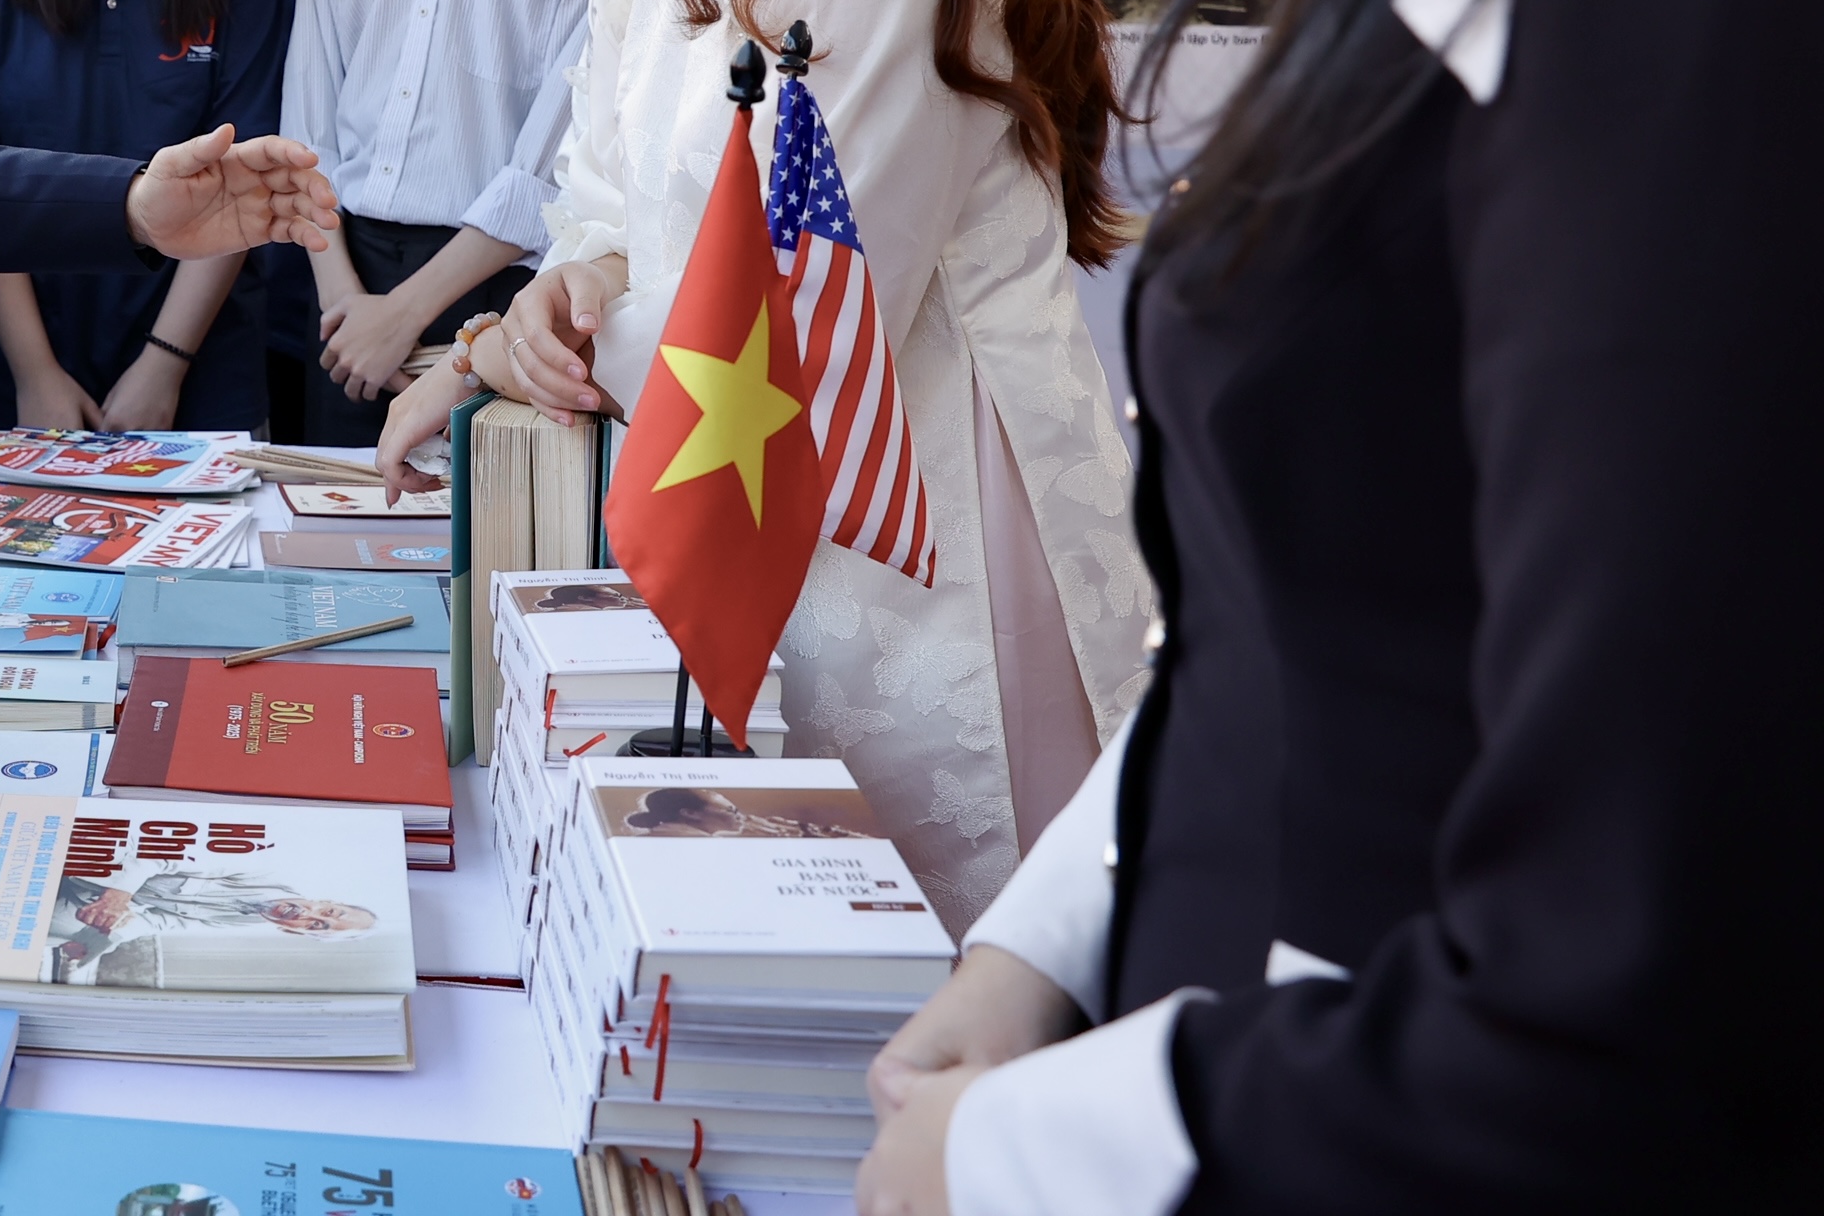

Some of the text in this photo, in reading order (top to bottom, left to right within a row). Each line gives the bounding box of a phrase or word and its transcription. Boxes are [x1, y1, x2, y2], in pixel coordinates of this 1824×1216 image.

[518, 576, 559, 584] Nguyễn
[307, 586, 341, 628] VIỆT NAM
[223, 704, 244, 739] (1975 2025)
[244, 692, 266, 755] XÂY DỰNG VÀ PHÁT TRIỂN
[268, 700, 315, 745] 50 NĂM
[603, 770, 720, 783] Nguyễn Thị Bình
[63, 817, 131, 878] Minh
[136, 820, 199, 862] Chí
[206, 823, 275, 854] Hồ
[7, 864, 26, 884] NAM
[772, 856, 863, 869] GIA ĐÌNH
[265, 1161, 297, 1178] 75
[322, 1166, 394, 1208] 75
